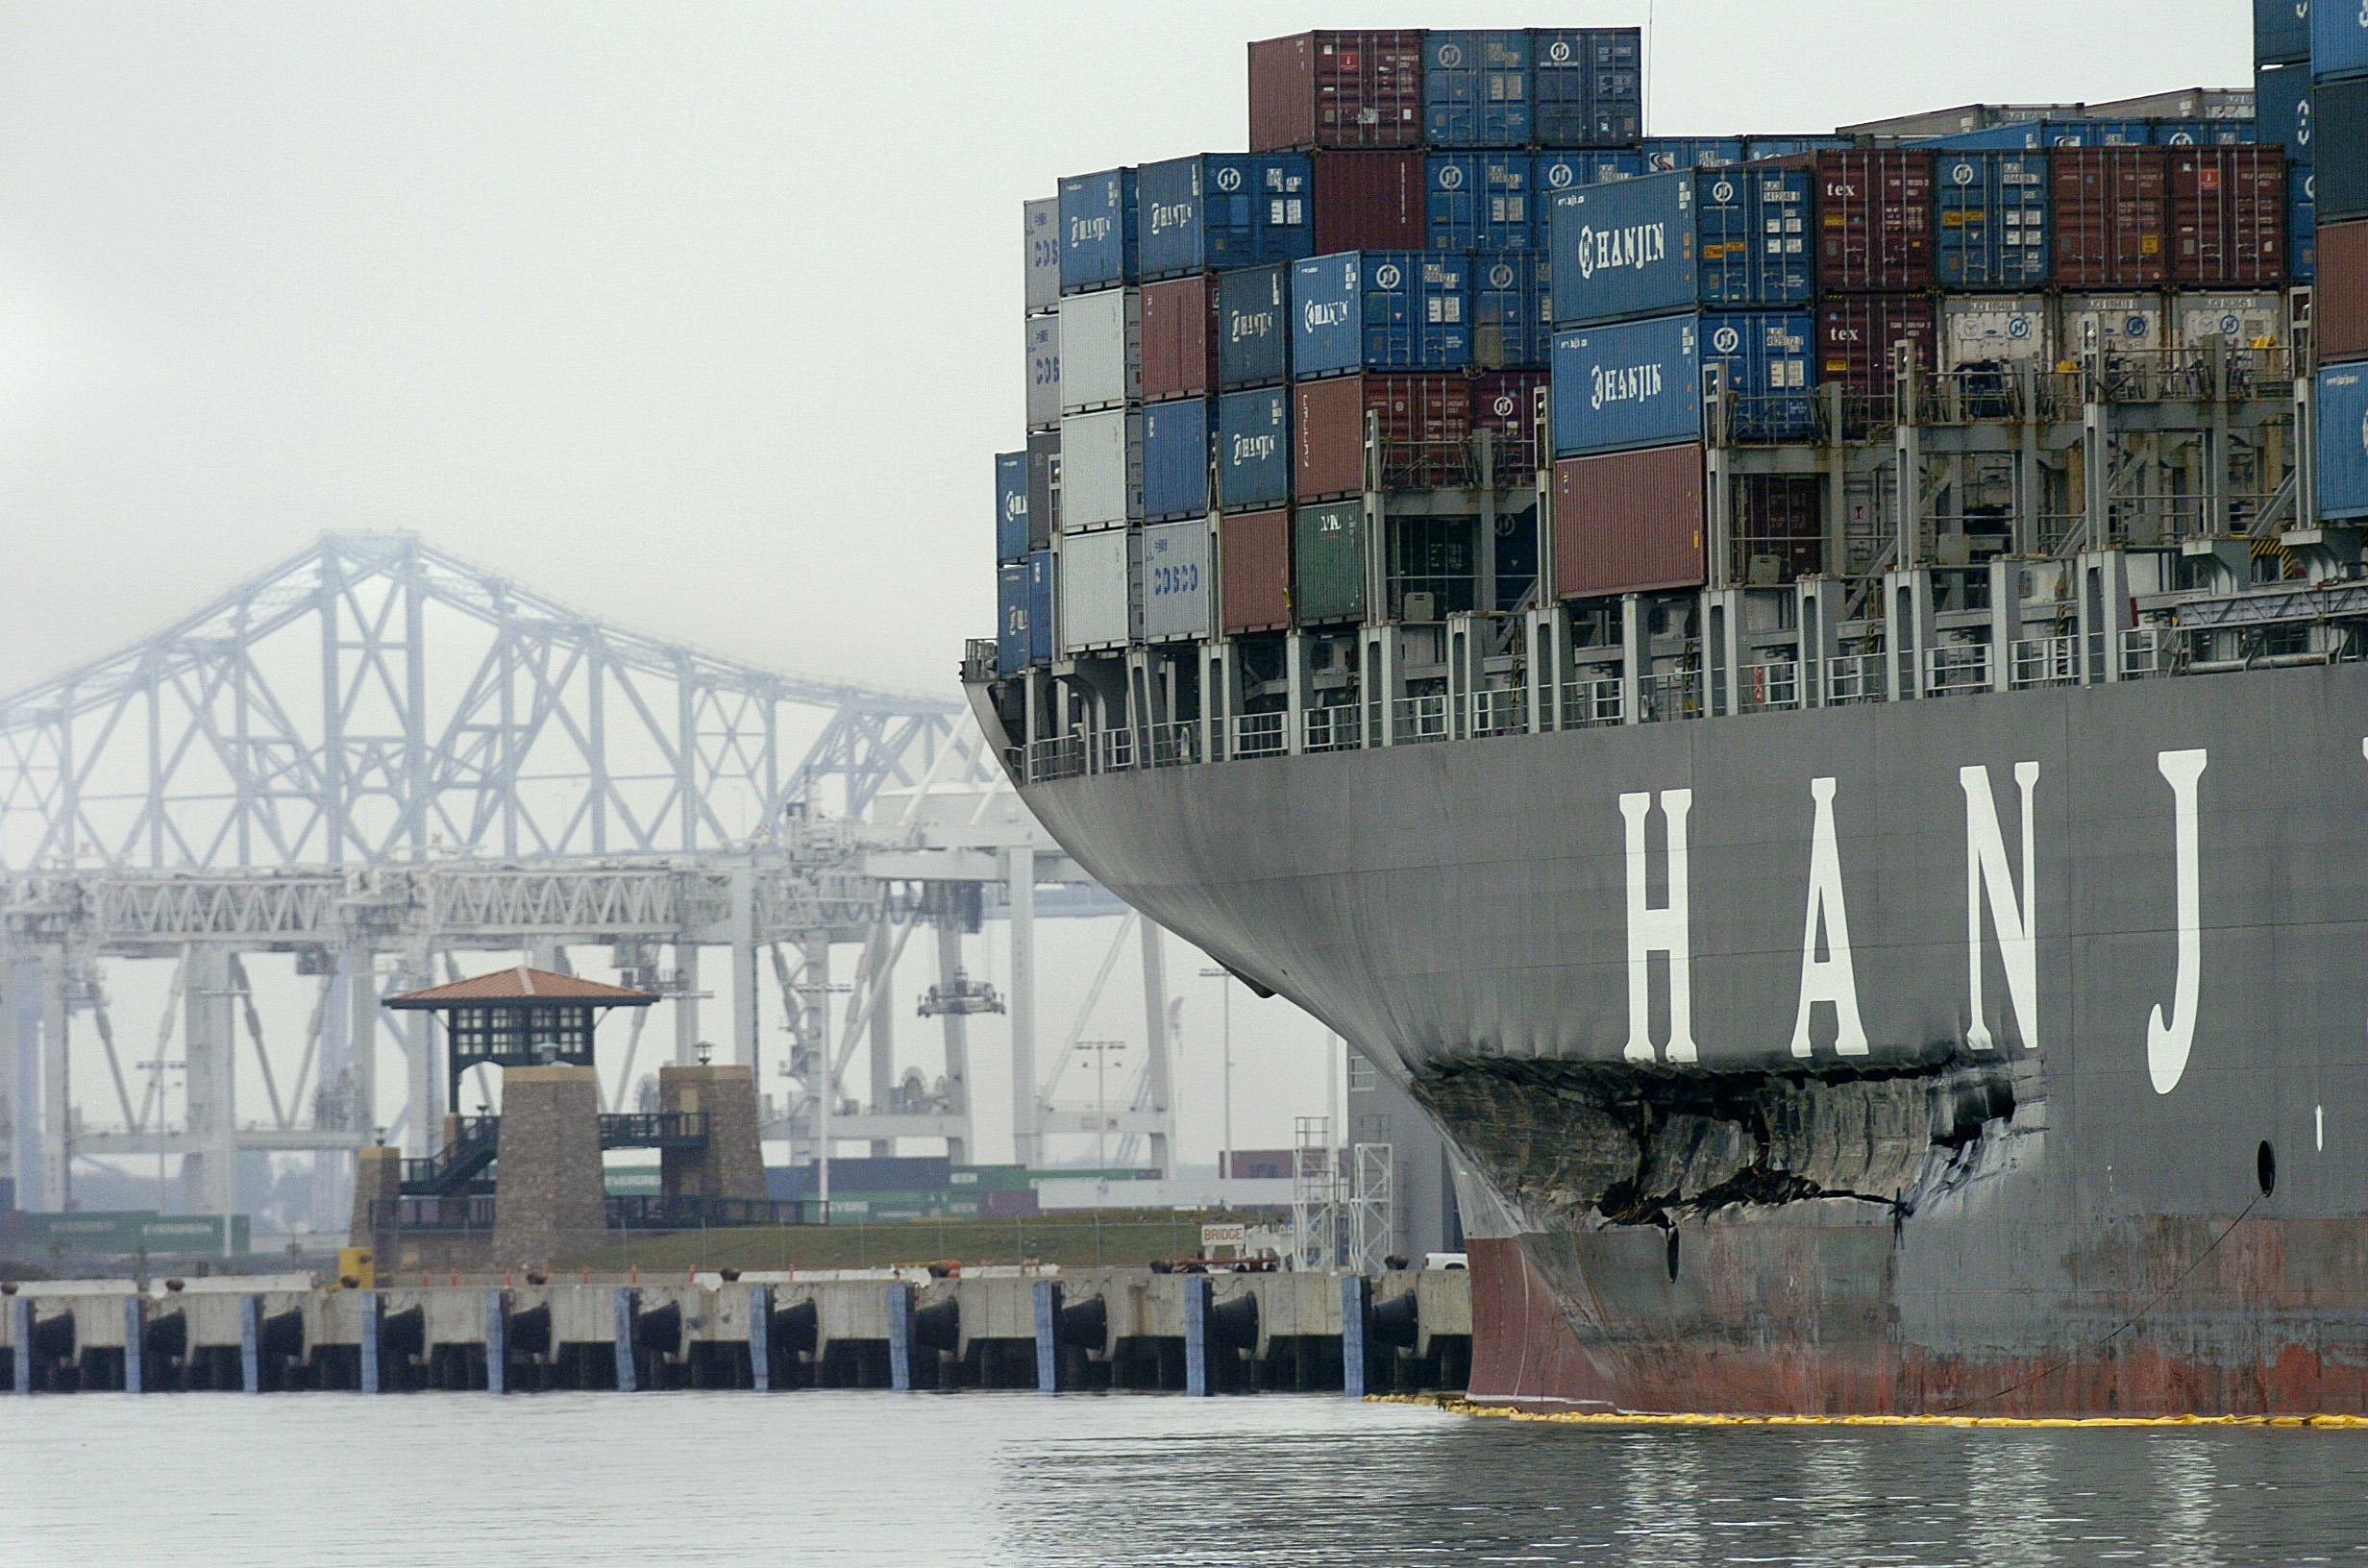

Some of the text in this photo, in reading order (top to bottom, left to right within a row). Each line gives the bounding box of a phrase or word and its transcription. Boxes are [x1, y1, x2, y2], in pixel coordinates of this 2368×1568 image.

[1828, 183, 1855, 196] tex
[1596, 223, 1665, 269] HANJIN
[1831, 327, 1858, 340] tex
[1605, 363, 1661, 402] HANJIN
[1619, 737, 2368, 1094] HANJ
[1204, 1229, 1243, 1240] BRIDGE
